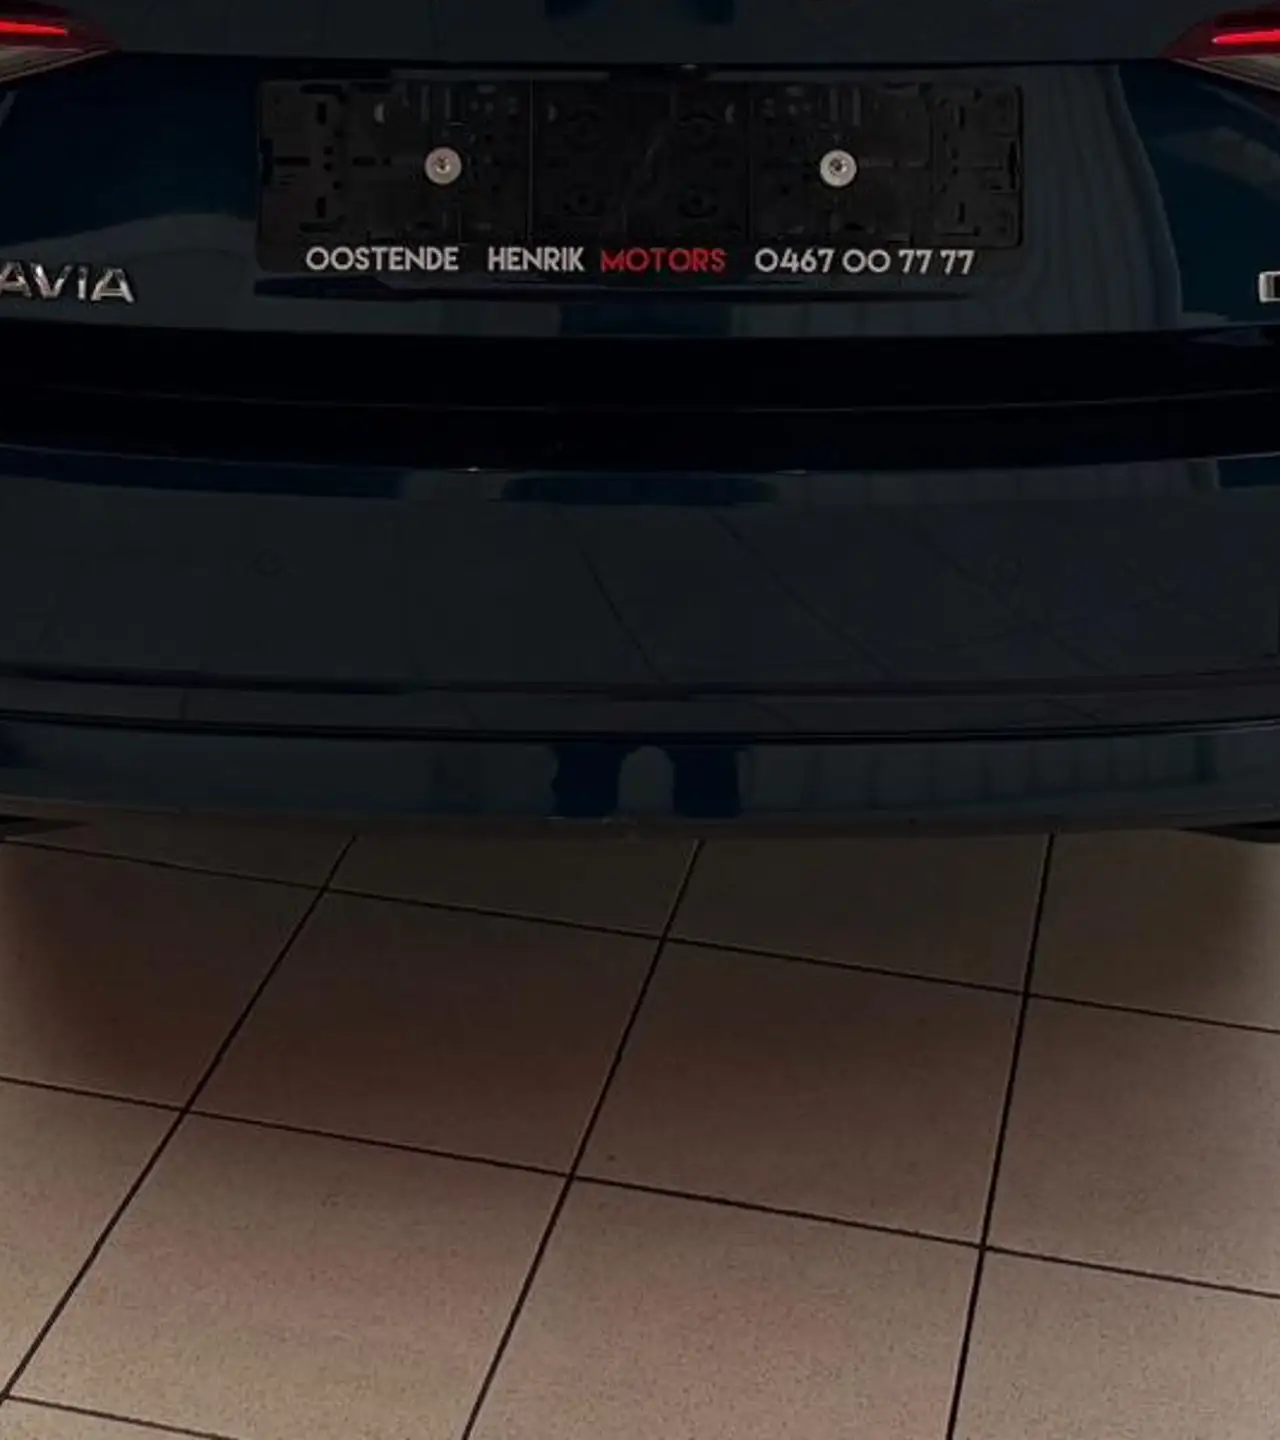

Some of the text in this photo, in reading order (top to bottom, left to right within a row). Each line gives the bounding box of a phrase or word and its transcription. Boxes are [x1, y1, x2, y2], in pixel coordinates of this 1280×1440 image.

[305, 246, 460, 272] OOSTENDE
[487, 246, 586, 272] HENRIK
[600, 248, 726, 273] MOTORS
[754, 249, 833, 274] 0467
[898, 249, 935, 275] 77
[940, 249, 975, 275] 77
